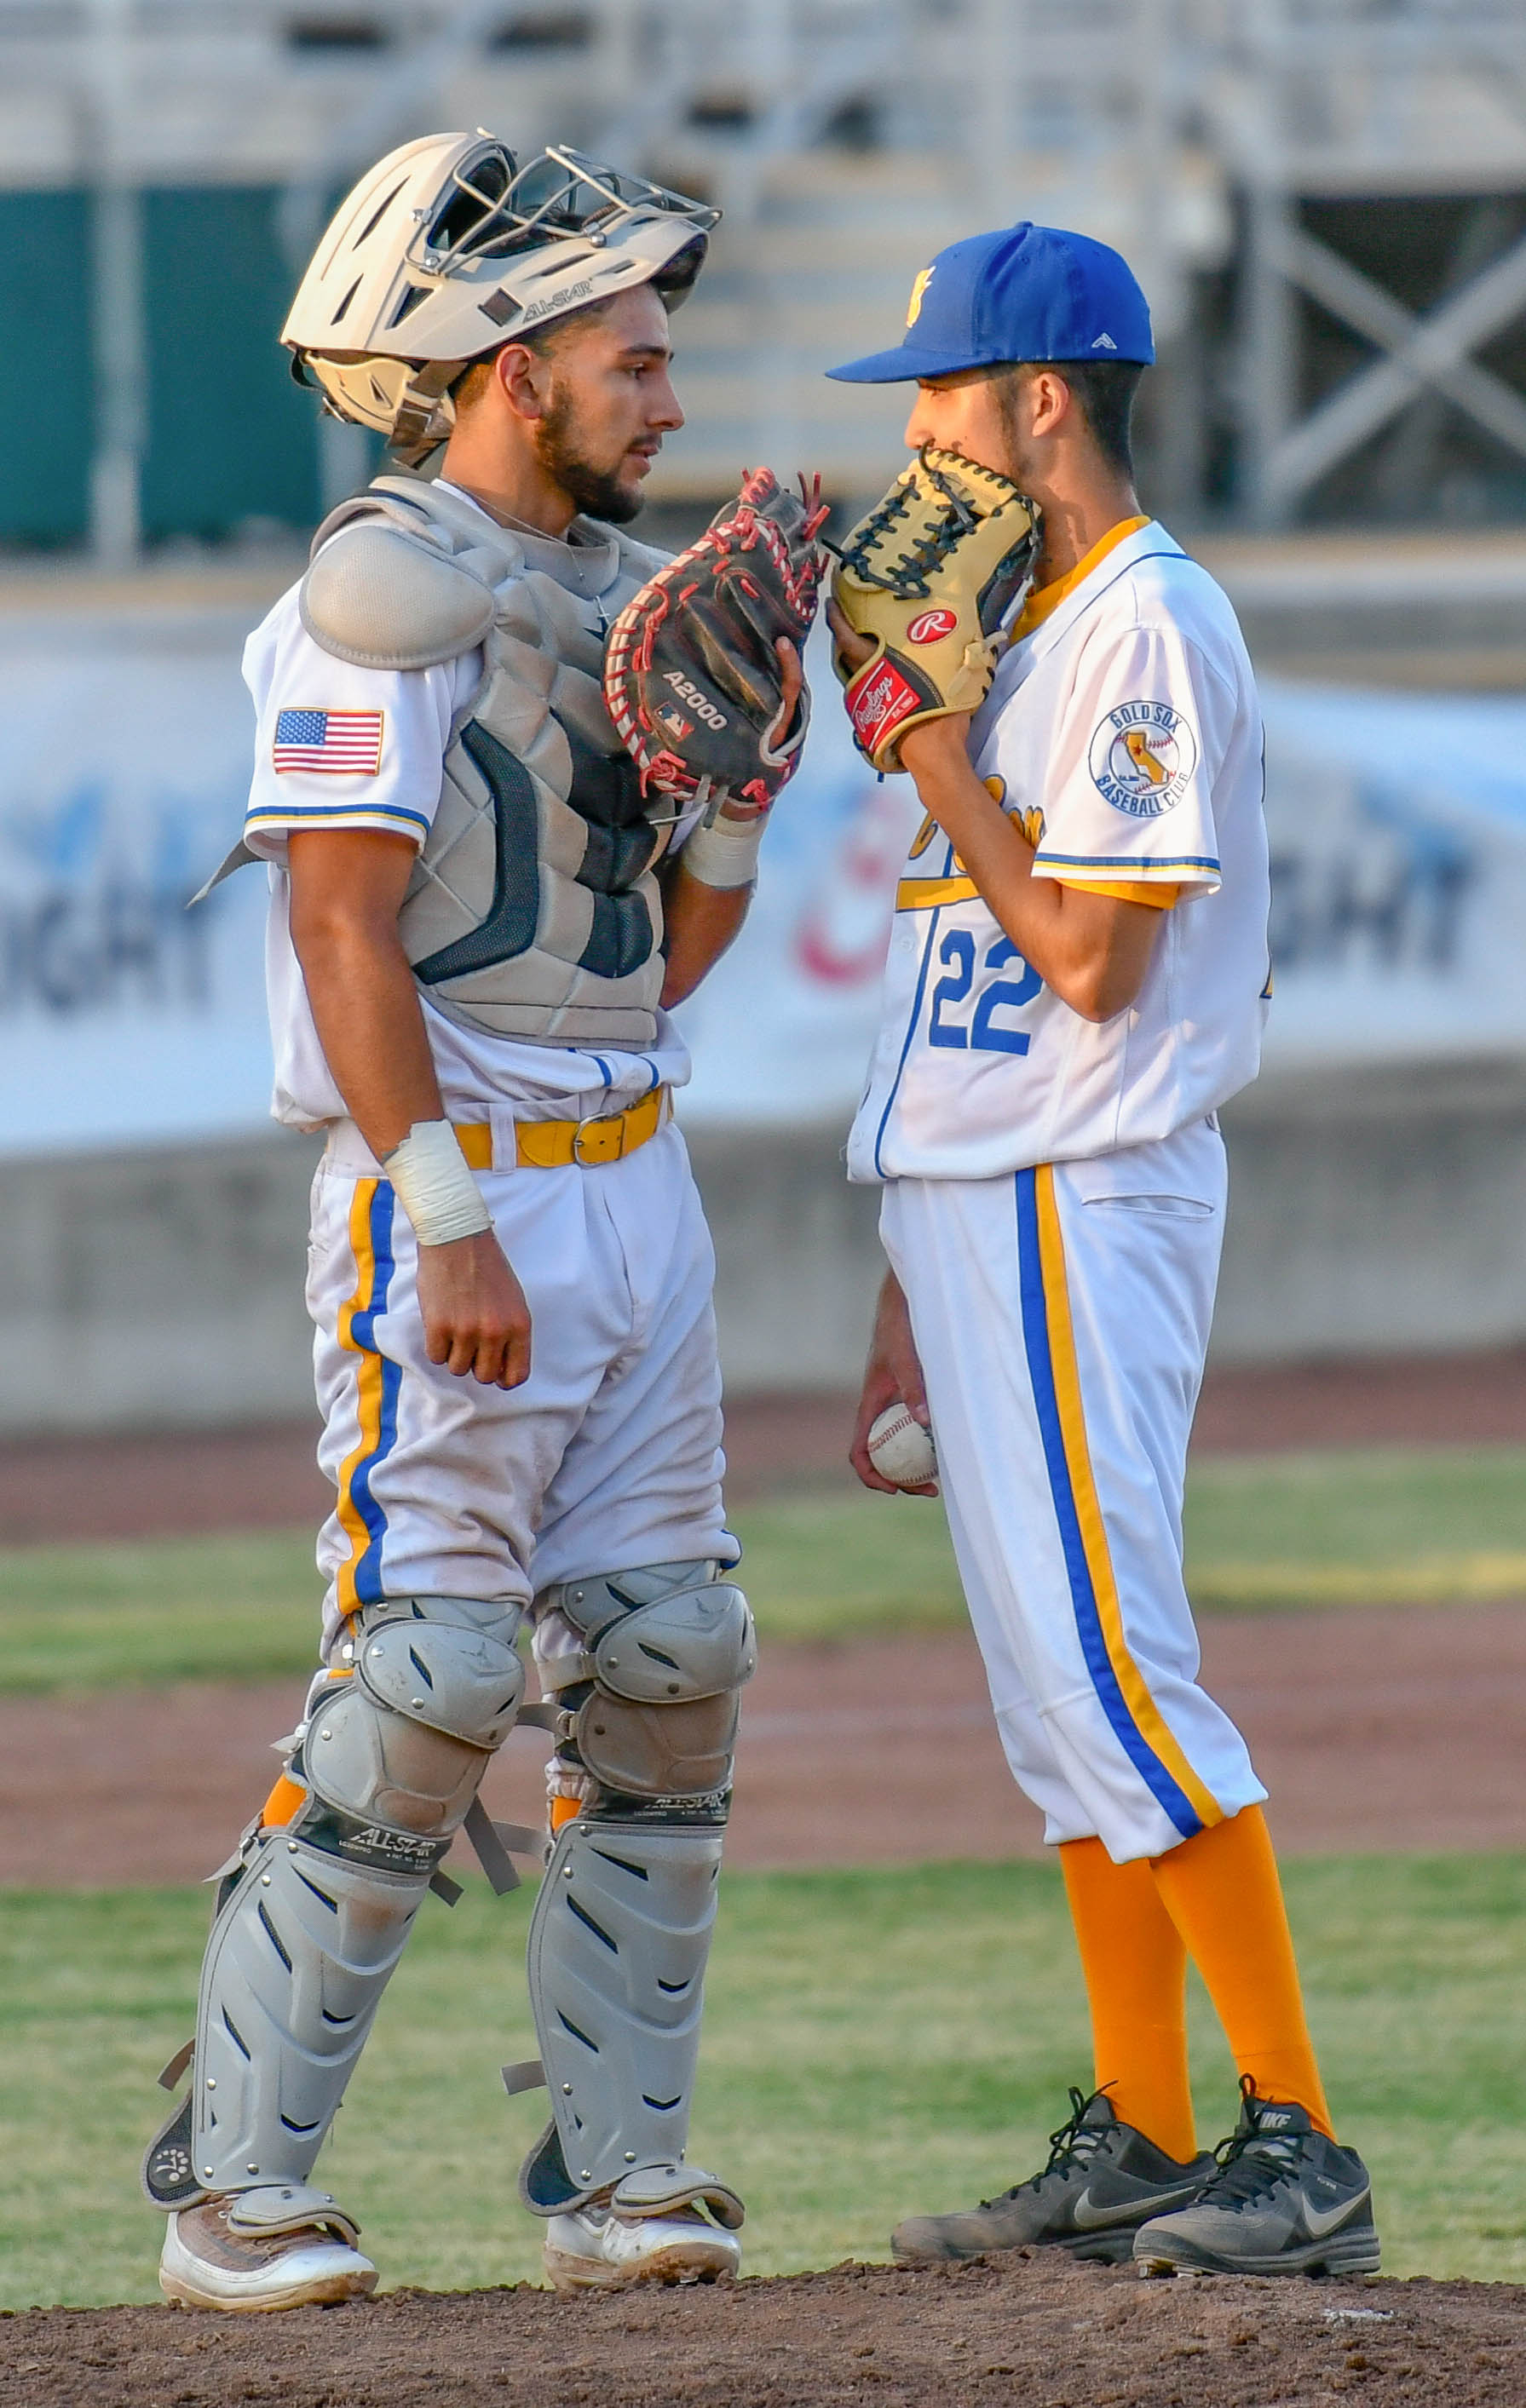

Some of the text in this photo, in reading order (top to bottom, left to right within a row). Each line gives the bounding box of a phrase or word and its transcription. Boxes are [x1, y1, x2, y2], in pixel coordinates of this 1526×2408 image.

[522, 279, 593, 324] ALL-STAR
[910, 611, 952, 641] R
[662, 670, 728, 731] A2000
[855, 676, 894, 733] Rawlings
[1109, 704, 1183, 734] GOLD SOX
[1097, 773, 1165, 815] BASEBALL
[929, 927, 1045, 1057] 22
[349, 1827, 437, 1857] ALL-STAR
